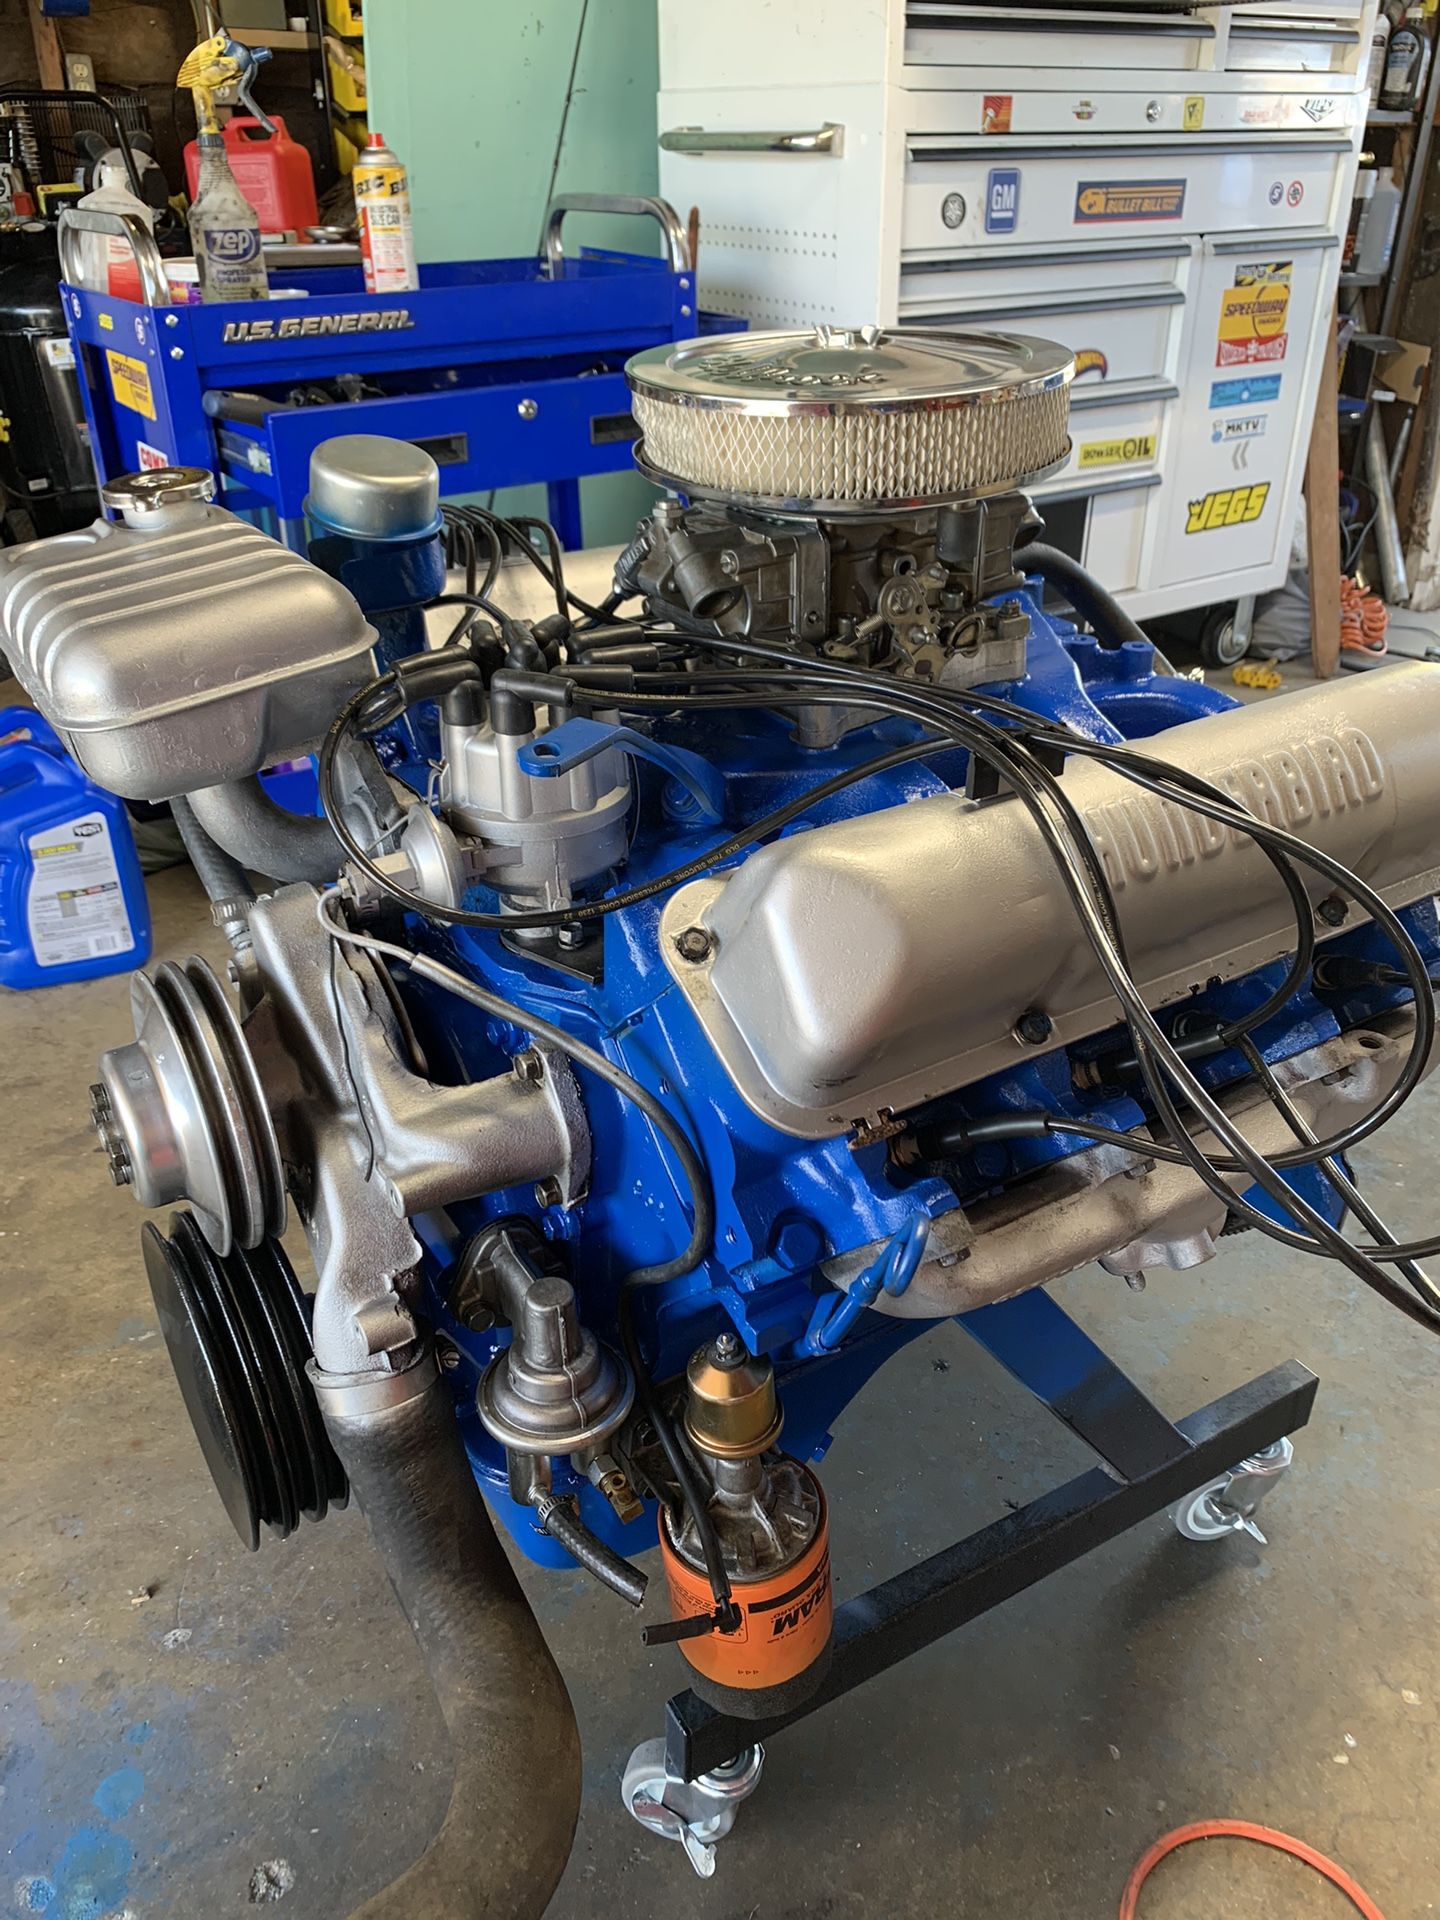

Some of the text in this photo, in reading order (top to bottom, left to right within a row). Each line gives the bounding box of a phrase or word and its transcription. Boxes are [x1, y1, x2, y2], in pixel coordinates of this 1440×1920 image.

[356, 175, 385, 196] BIG
[992, 184, 1016, 211] GM
[1226, 419, 1260, 434] MKTV
[1185, 481, 1272, 535] JEGS
[673, 861, 708, 881] SILICONE
[621, 878, 673, 904] SUPPRESSION
[599, 900, 621, 912] CORE
